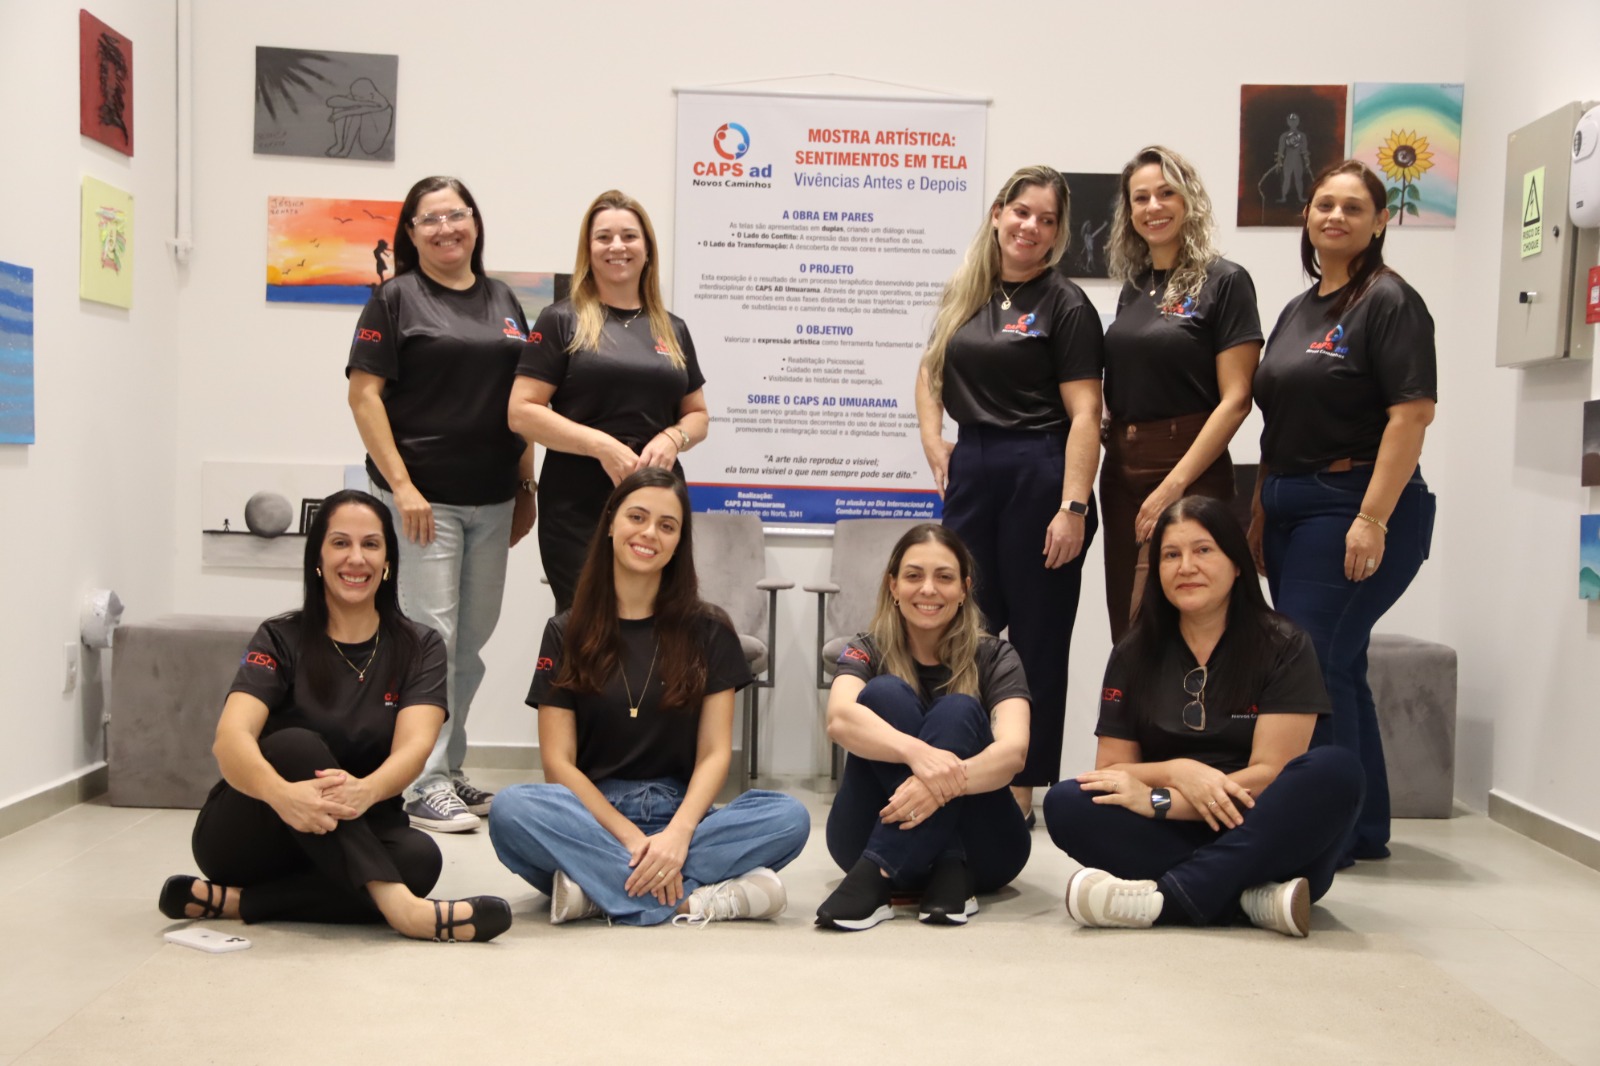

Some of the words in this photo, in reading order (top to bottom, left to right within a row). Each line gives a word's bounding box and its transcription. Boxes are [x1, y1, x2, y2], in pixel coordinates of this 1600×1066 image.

[808, 128, 870, 144] MOSTRA
[874, 126, 956, 146] ARTÍSTICA:
[795, 150, 899, 167] SENTIMENTOS
[904, 153, 927, 168] EM
[931, 154, 967, 169] TELA
[692, 161, 743, 177] CAPS
[748, 163, 772, 178] ad
[692, 178, 722, 187] Novos
[724, 179, 771, 188] Caminhos
[793, 171, 859, 188] Vivências
[863, 174, 902, 189] Antes
[906, 178, 915, 190] e
[919, 175, 967, 193] Depois
[782, 209, 789, 219] A
[792, 210, 819, 220] OBRA
[822, 211, 838, 221] EM
[840, 211, 873, 222] PARES
[1523, 228, 1534, 239] RISCO
[1534, 226, 1540, 236] DE
[1523, 239, 1539, 252] CHOQUE
[799, 263, 806, 272] O
[809, 264, 853, 274] PROJETO
[796, 324, 803, 333] O
[806, 325, 853, 335] OBJETIVO
[747, 394, 779, 404] SOBRE
[783, 395, 790, 404] O
[793, 395, 819, 405] CAPS
[822, 396, 835, 406] AD
[839, 397, 897, 407] UMUARAMA
[764, 454, 773, 462] "A
[774, 455, 791, 463] arte
[792, 455, 807, 464] não
[808, 456, 844, 465] reproduz
[725, 465, 737, 473] ela
[738, 466, 759, 474] torna
[794, 468, 809, 477] que
[829, 469, 859, 478] sempre
[859, 470, 880, 479] pode
[895, 470, 917, 479] dito."
